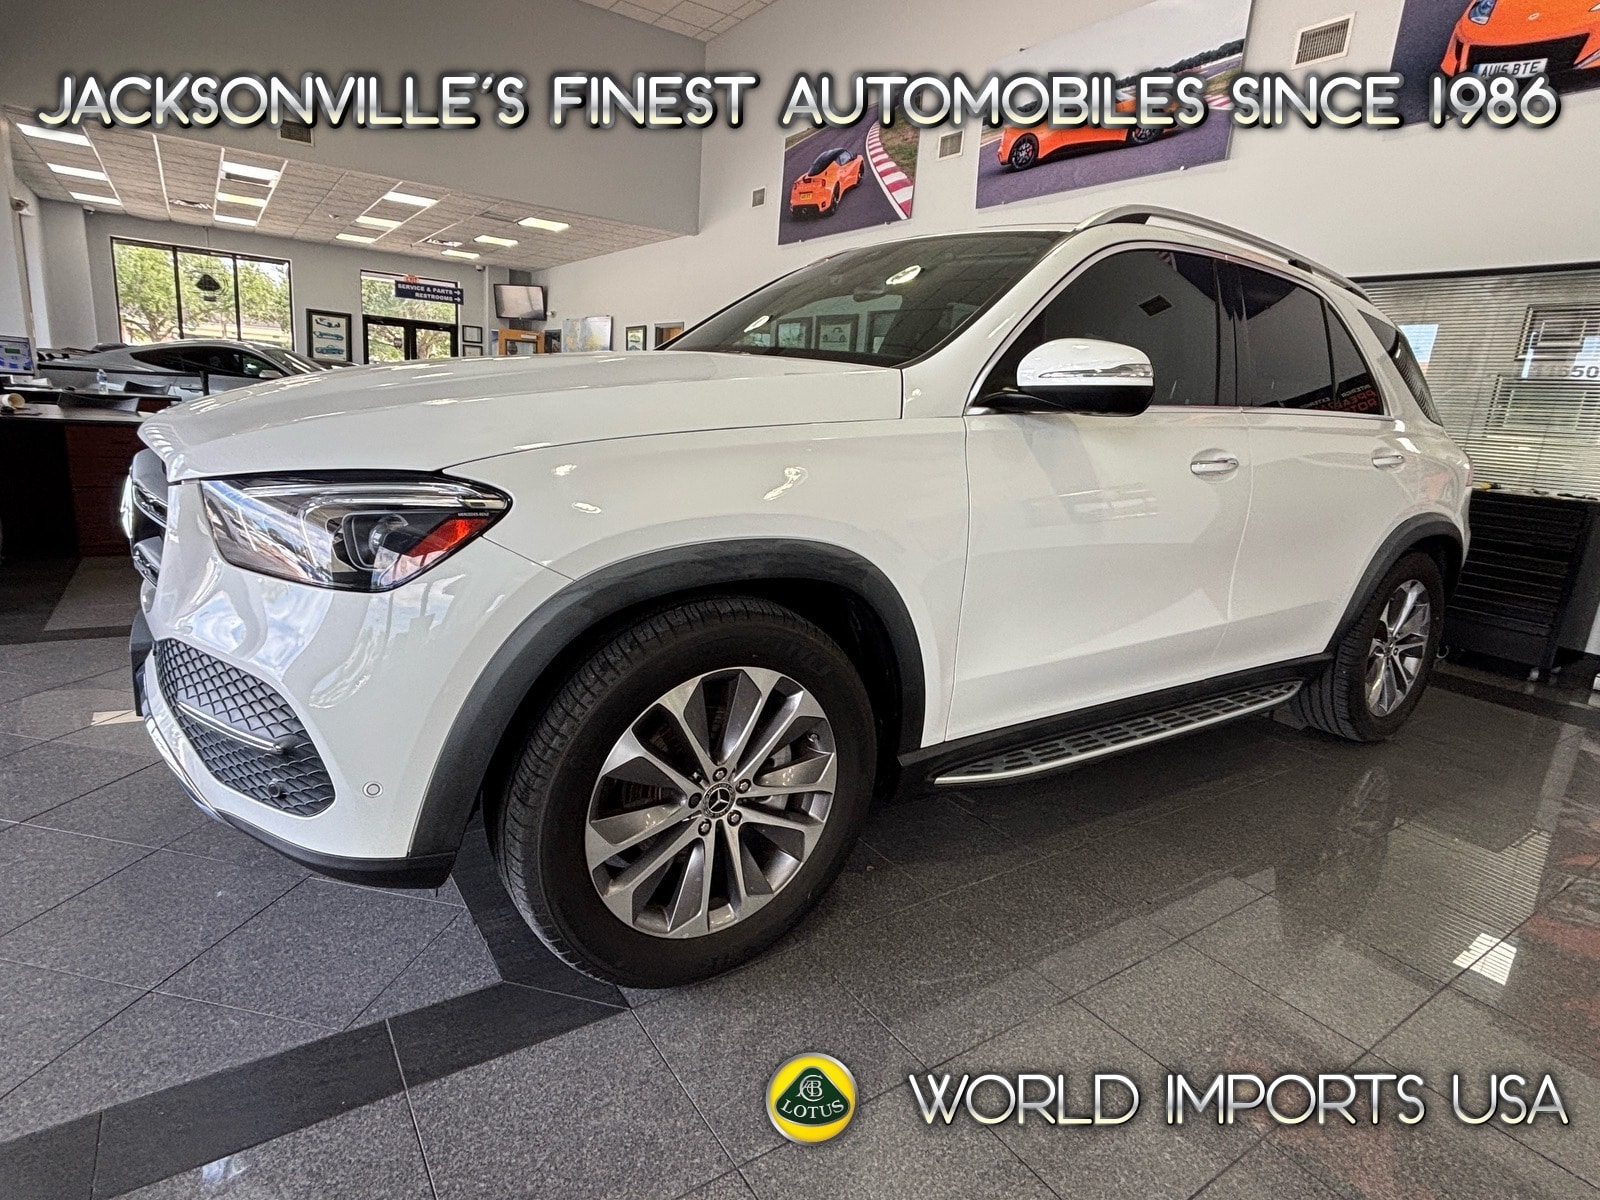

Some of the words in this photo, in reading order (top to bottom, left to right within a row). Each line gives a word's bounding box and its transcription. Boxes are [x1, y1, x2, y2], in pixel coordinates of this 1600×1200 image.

[1511, 61, 1542, 76] BTE
[397, 283, 425, 291] SERVICE
[432, 287, 453, 295] PARTS
[414, 292, 453, 301] RESTROOMS
